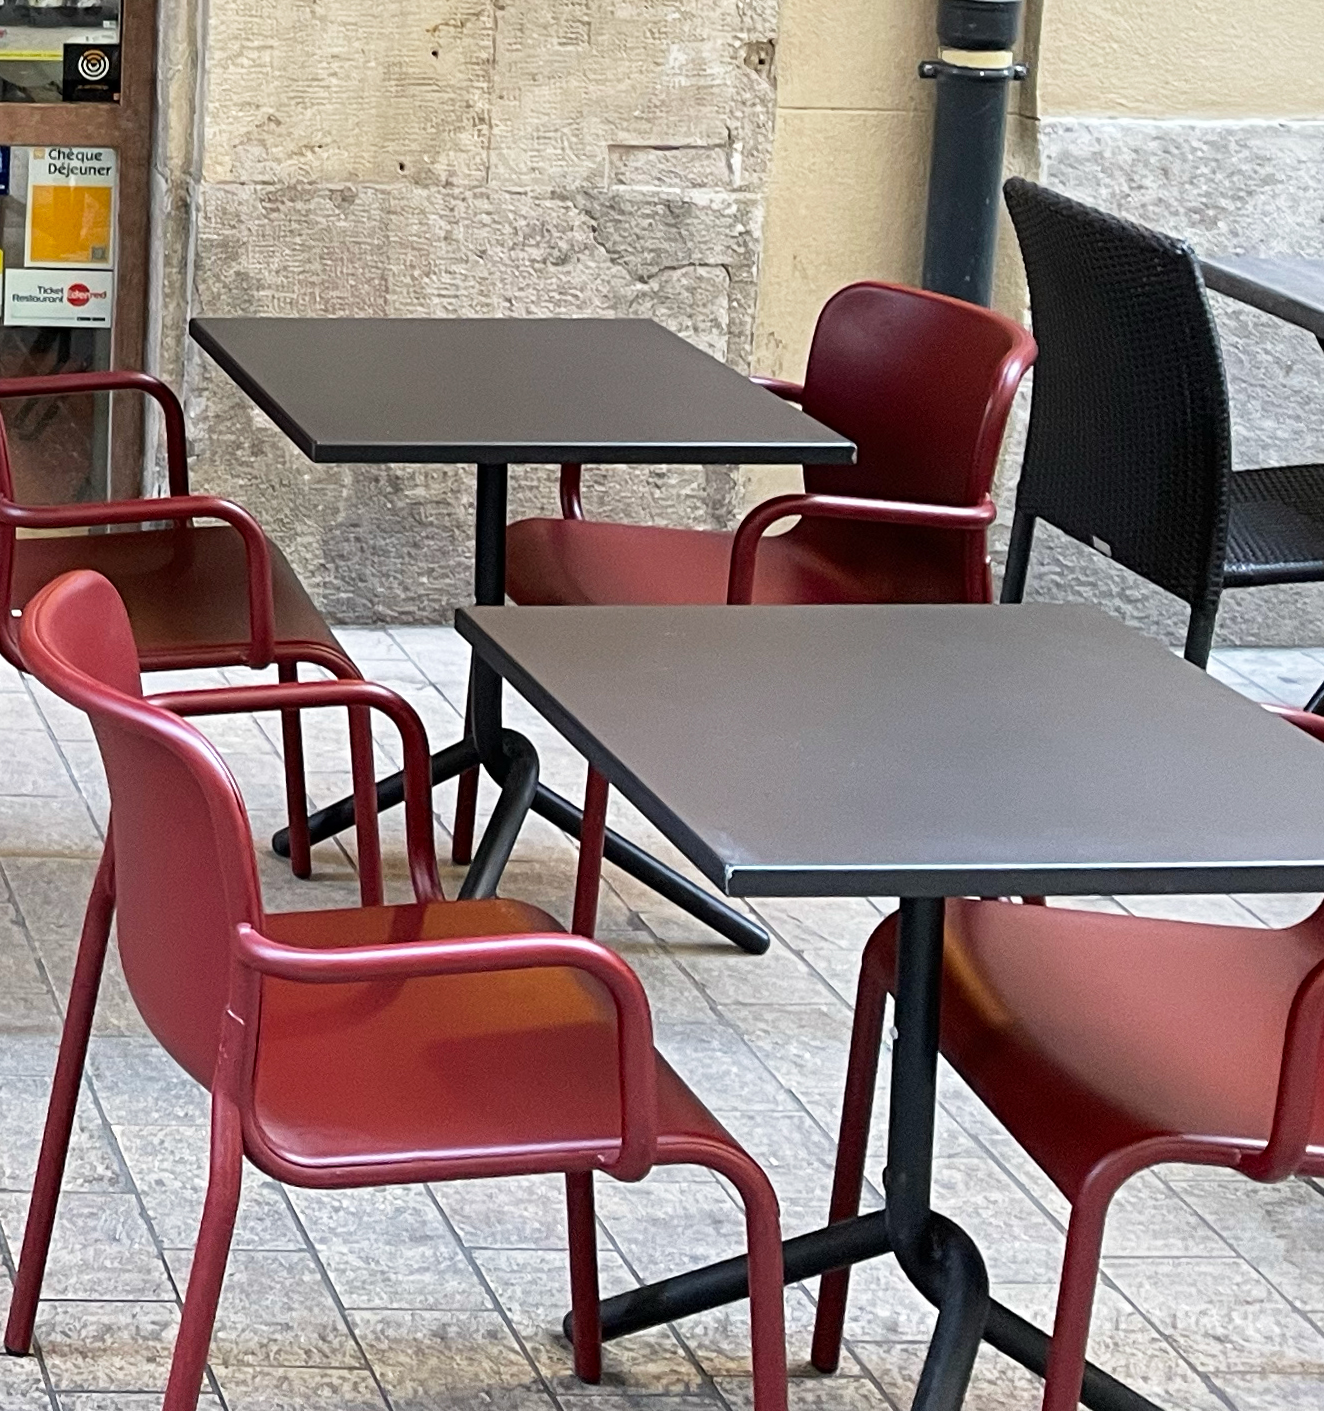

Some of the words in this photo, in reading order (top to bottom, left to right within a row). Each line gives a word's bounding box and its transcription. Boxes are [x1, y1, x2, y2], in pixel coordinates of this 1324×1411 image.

[48, 147, 103, 163] Chèque
[48, 162, 112, 178] Déjeuner
[38, 286, 63, 295] Ticket
[12, 294, 64, 304] Restaurant
